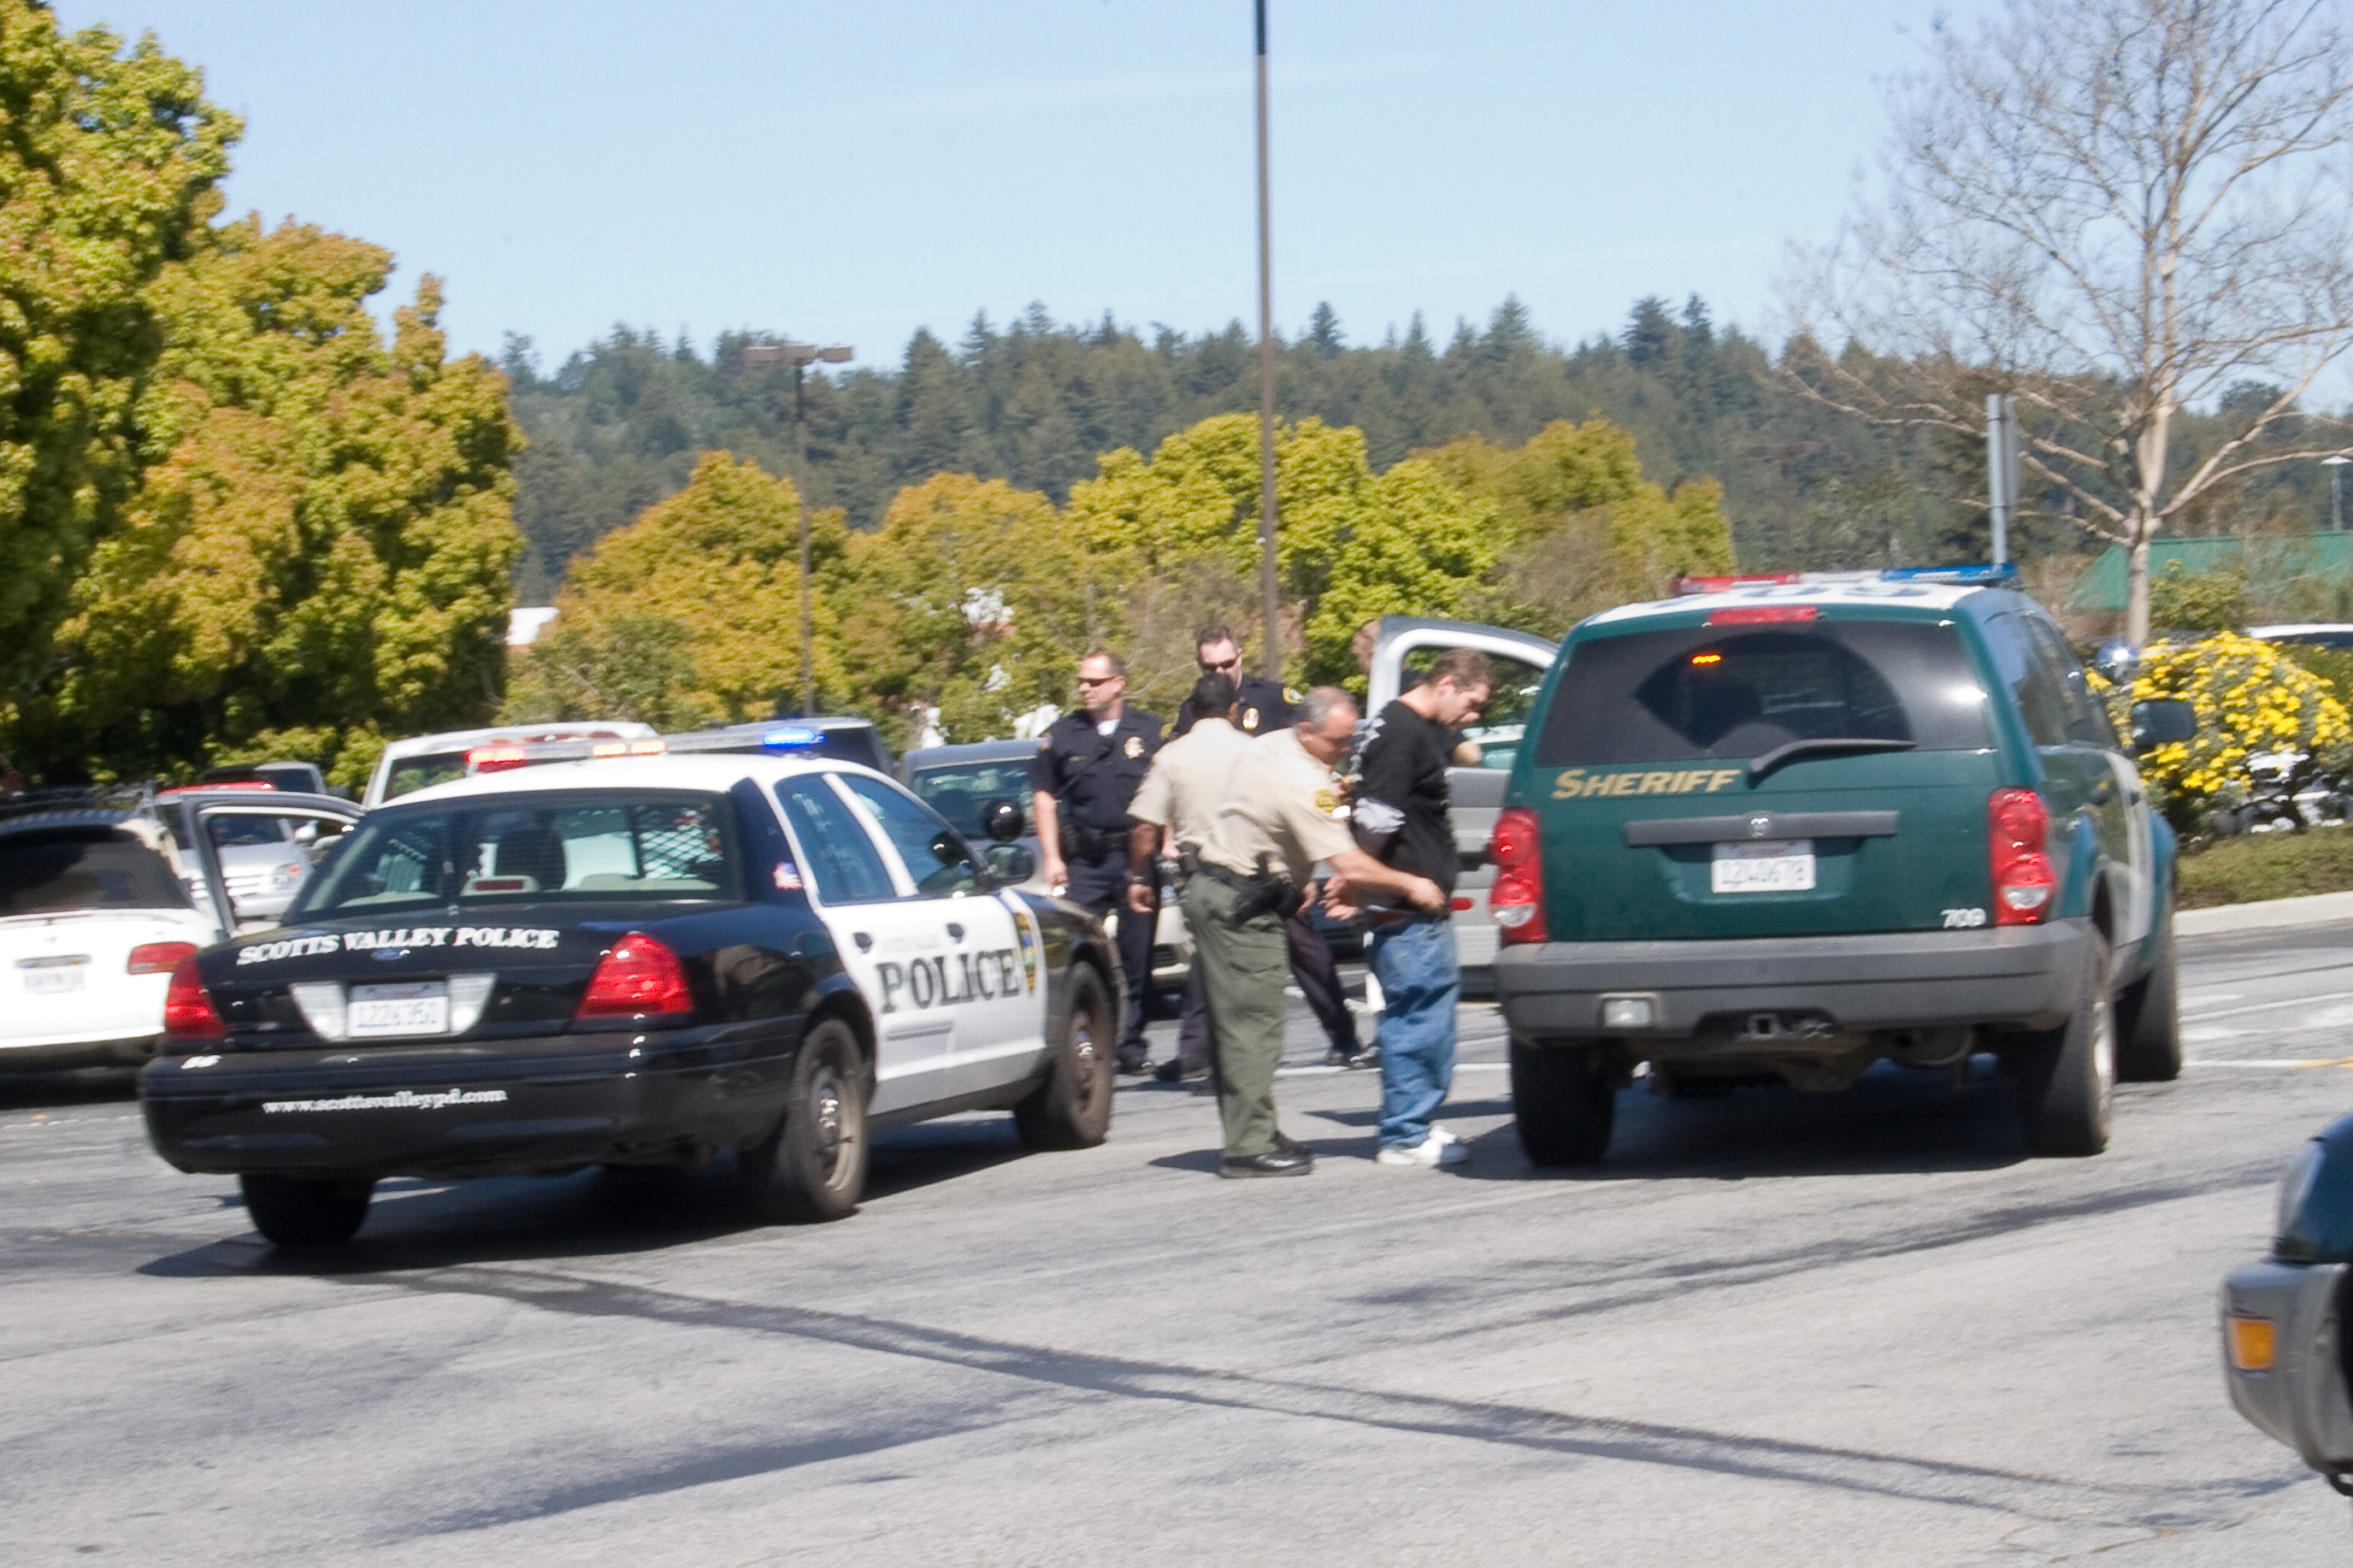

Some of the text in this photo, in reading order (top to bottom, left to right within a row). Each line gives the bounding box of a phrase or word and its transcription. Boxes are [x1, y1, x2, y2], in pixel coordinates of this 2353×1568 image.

[1550, 769, 1741, 799] SHERIFF
[1940, 907, 1987, 928] 709
[236, 927, 559, 966] SCOTTS VALLEY POLICE
[876, 949, 1020, 1013] POLICE
